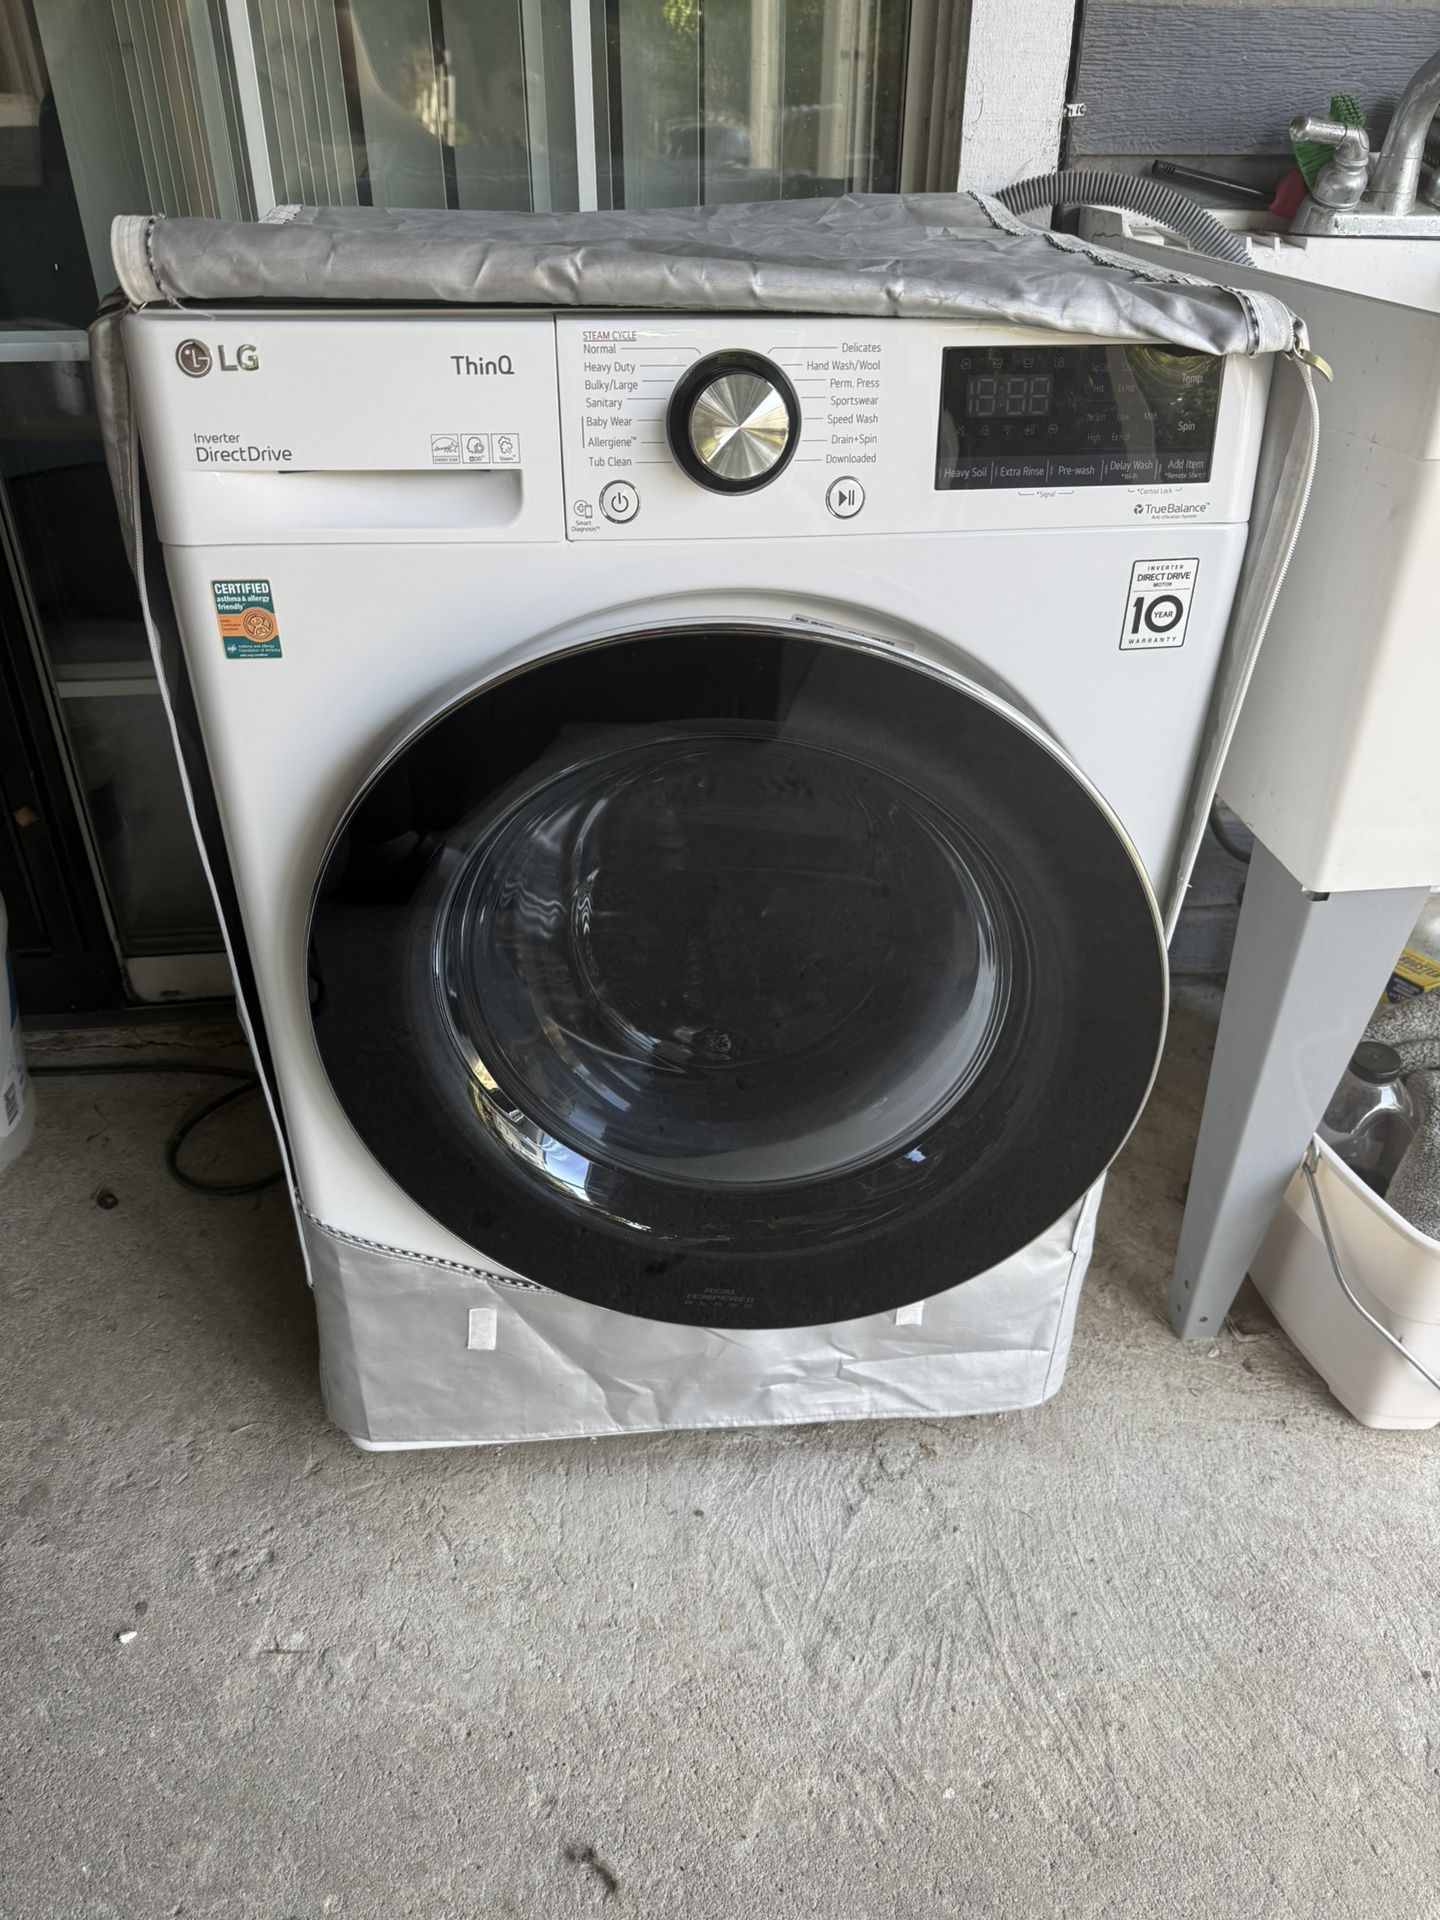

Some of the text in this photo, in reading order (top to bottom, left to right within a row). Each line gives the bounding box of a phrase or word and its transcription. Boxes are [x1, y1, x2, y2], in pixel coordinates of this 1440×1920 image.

[583, 331, 637, 340] STEAM CYCLE
[583, 343, 616, 354] Normal
[842, 342, 881, 353] Delicates
[218, 344, 260, 371] LG
[450, 355, 515, 375] ThinQ
[584, 361, 636, 375] Heavy Duty
[807, 359, 881, 371] Hand Wash/Wool
[830, 377, 880, 388] Perm. Press
[1182, 373, 1204, 384] Temp.
[585, 378, 638, 393] Bulky/Large
[586, 397, 623, 410] Sanitary
[830, 395, 879, 408] Sportswear
[586, 416, 632, 429] Baby Wear
[827, 414, 878, 426] Speed Wash
[1177, 421, 1196, 432] Spin
[193, 432, 240, 443] Inverter
[831, 434, 877, 446] Drain+Spin
[588, 456, 632, 467] Tub Clean
[826, 453, 877, 464] Downloaded
[1168, 459, 1204, 469] Add Item
[1000, 466, 1044, 476] Extra Rinse
[1058, 465, 1095, 475] Pre-wash
[1110, 460, 1153, 472] Delay Wash
[944, 467, 988, 480] Heavy Soil
[1137, 571, 1191, 582] DIRECT DRIVE
[214, 583, 269, 594] CERTIFIED
[247, 595, 270, 603] allergy
[1131, 594, 1184, 634] 10
[1154, 611, 1174, 619] YEAR
[1128, 636, 1177, 644] WARRANTY
